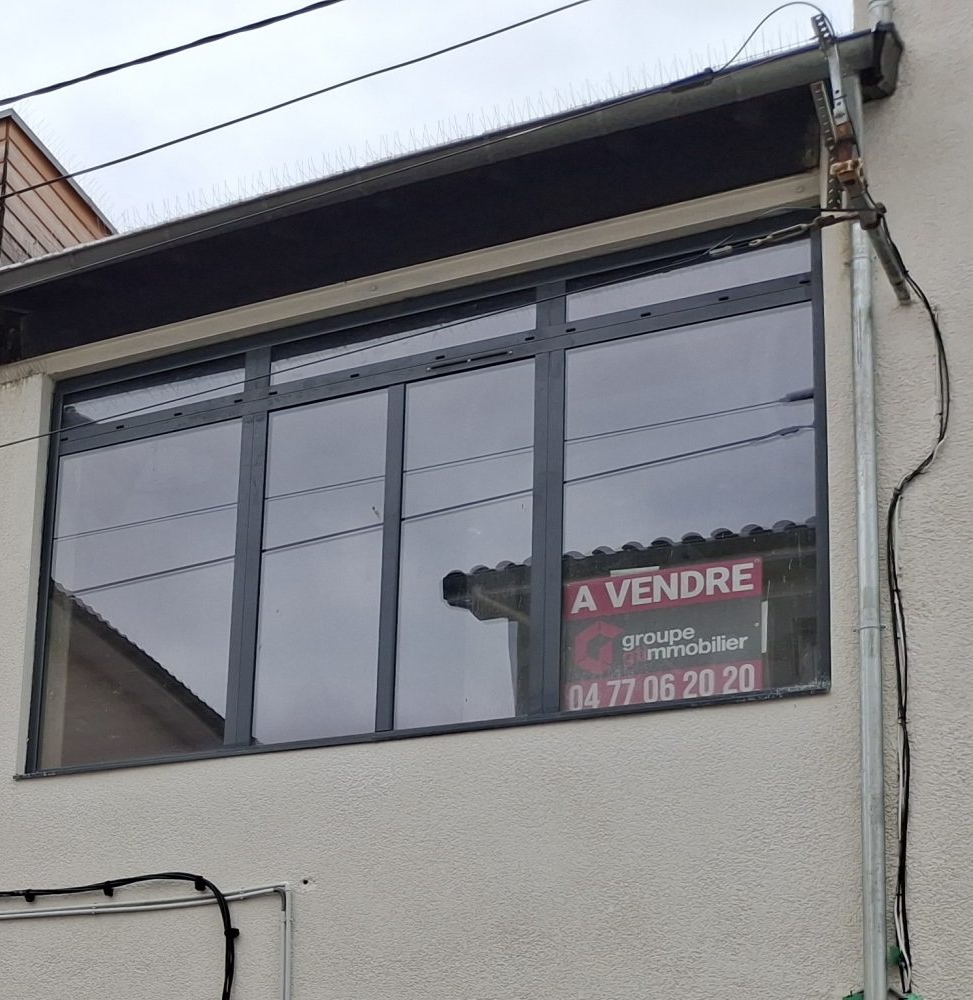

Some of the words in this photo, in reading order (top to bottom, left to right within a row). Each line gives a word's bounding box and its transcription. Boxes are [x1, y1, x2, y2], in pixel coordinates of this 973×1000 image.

[571, 585, 598, 614] A
[605, 562, 755, 607] VENDRE
[622, 627, 695, 651] groupe
[569, 682, 600, 711] 04
[607, 678, 636, 707] 77
[643, 673, 675, 703] 06
[683, 670, 715, 699] 20
[722, 663, 755, 694] 20
